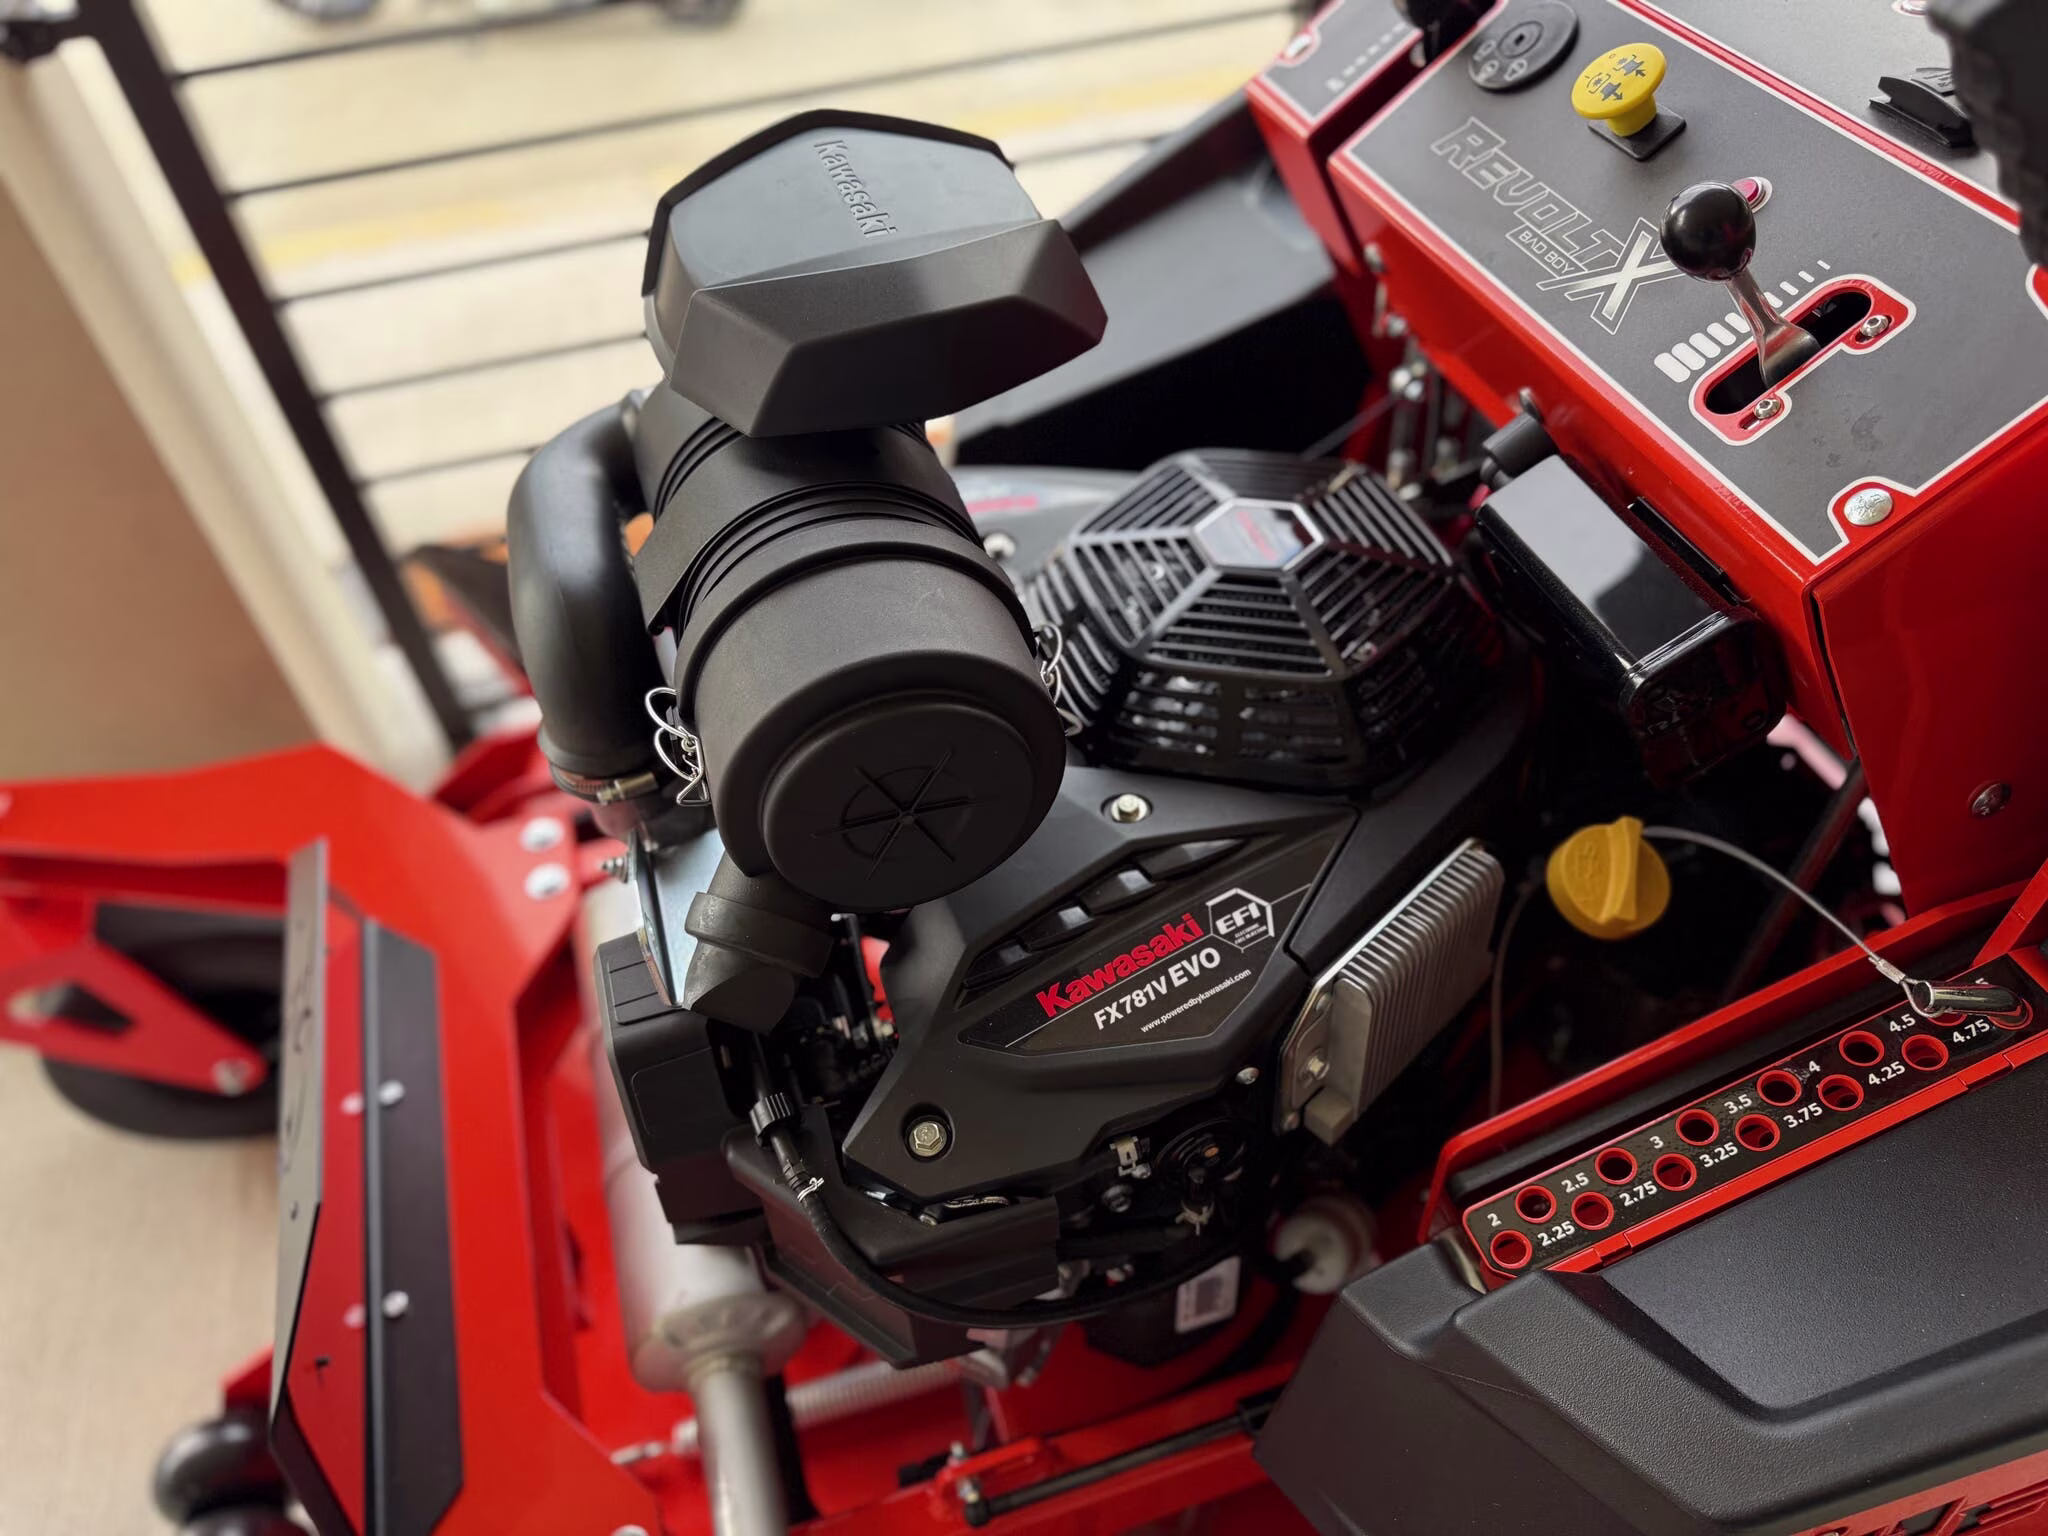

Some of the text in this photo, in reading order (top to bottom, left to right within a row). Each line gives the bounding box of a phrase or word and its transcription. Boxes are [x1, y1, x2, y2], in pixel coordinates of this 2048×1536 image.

[813, 139, 898, 238] Kawasaki
[1518, 230, 1575, 274] BAD BOY
[1215, 902, 1261, 934] EFI
[1036, 913, 1204, 1017] Kawasaki
[1094, 947, 1221, 1030] FX781V EVO
[1140, 969, 1251, 1033] www.poweredbykawasaki.com
[1487, 1213, 1502, 1227] 2
[1561, 1172, 1589, 1193] 2.5
[1650, 1135, 1664, 1149] 3
[1724, 1094, 1752, 1114] 3.5
[1808, 1060, 1821, 1072] 4
[1889, 1013, 1916, 1032] 4.5
[1537, 1019, 1990, 1246] 2.25 2.75 3.25 3.75 4.25 4.75
